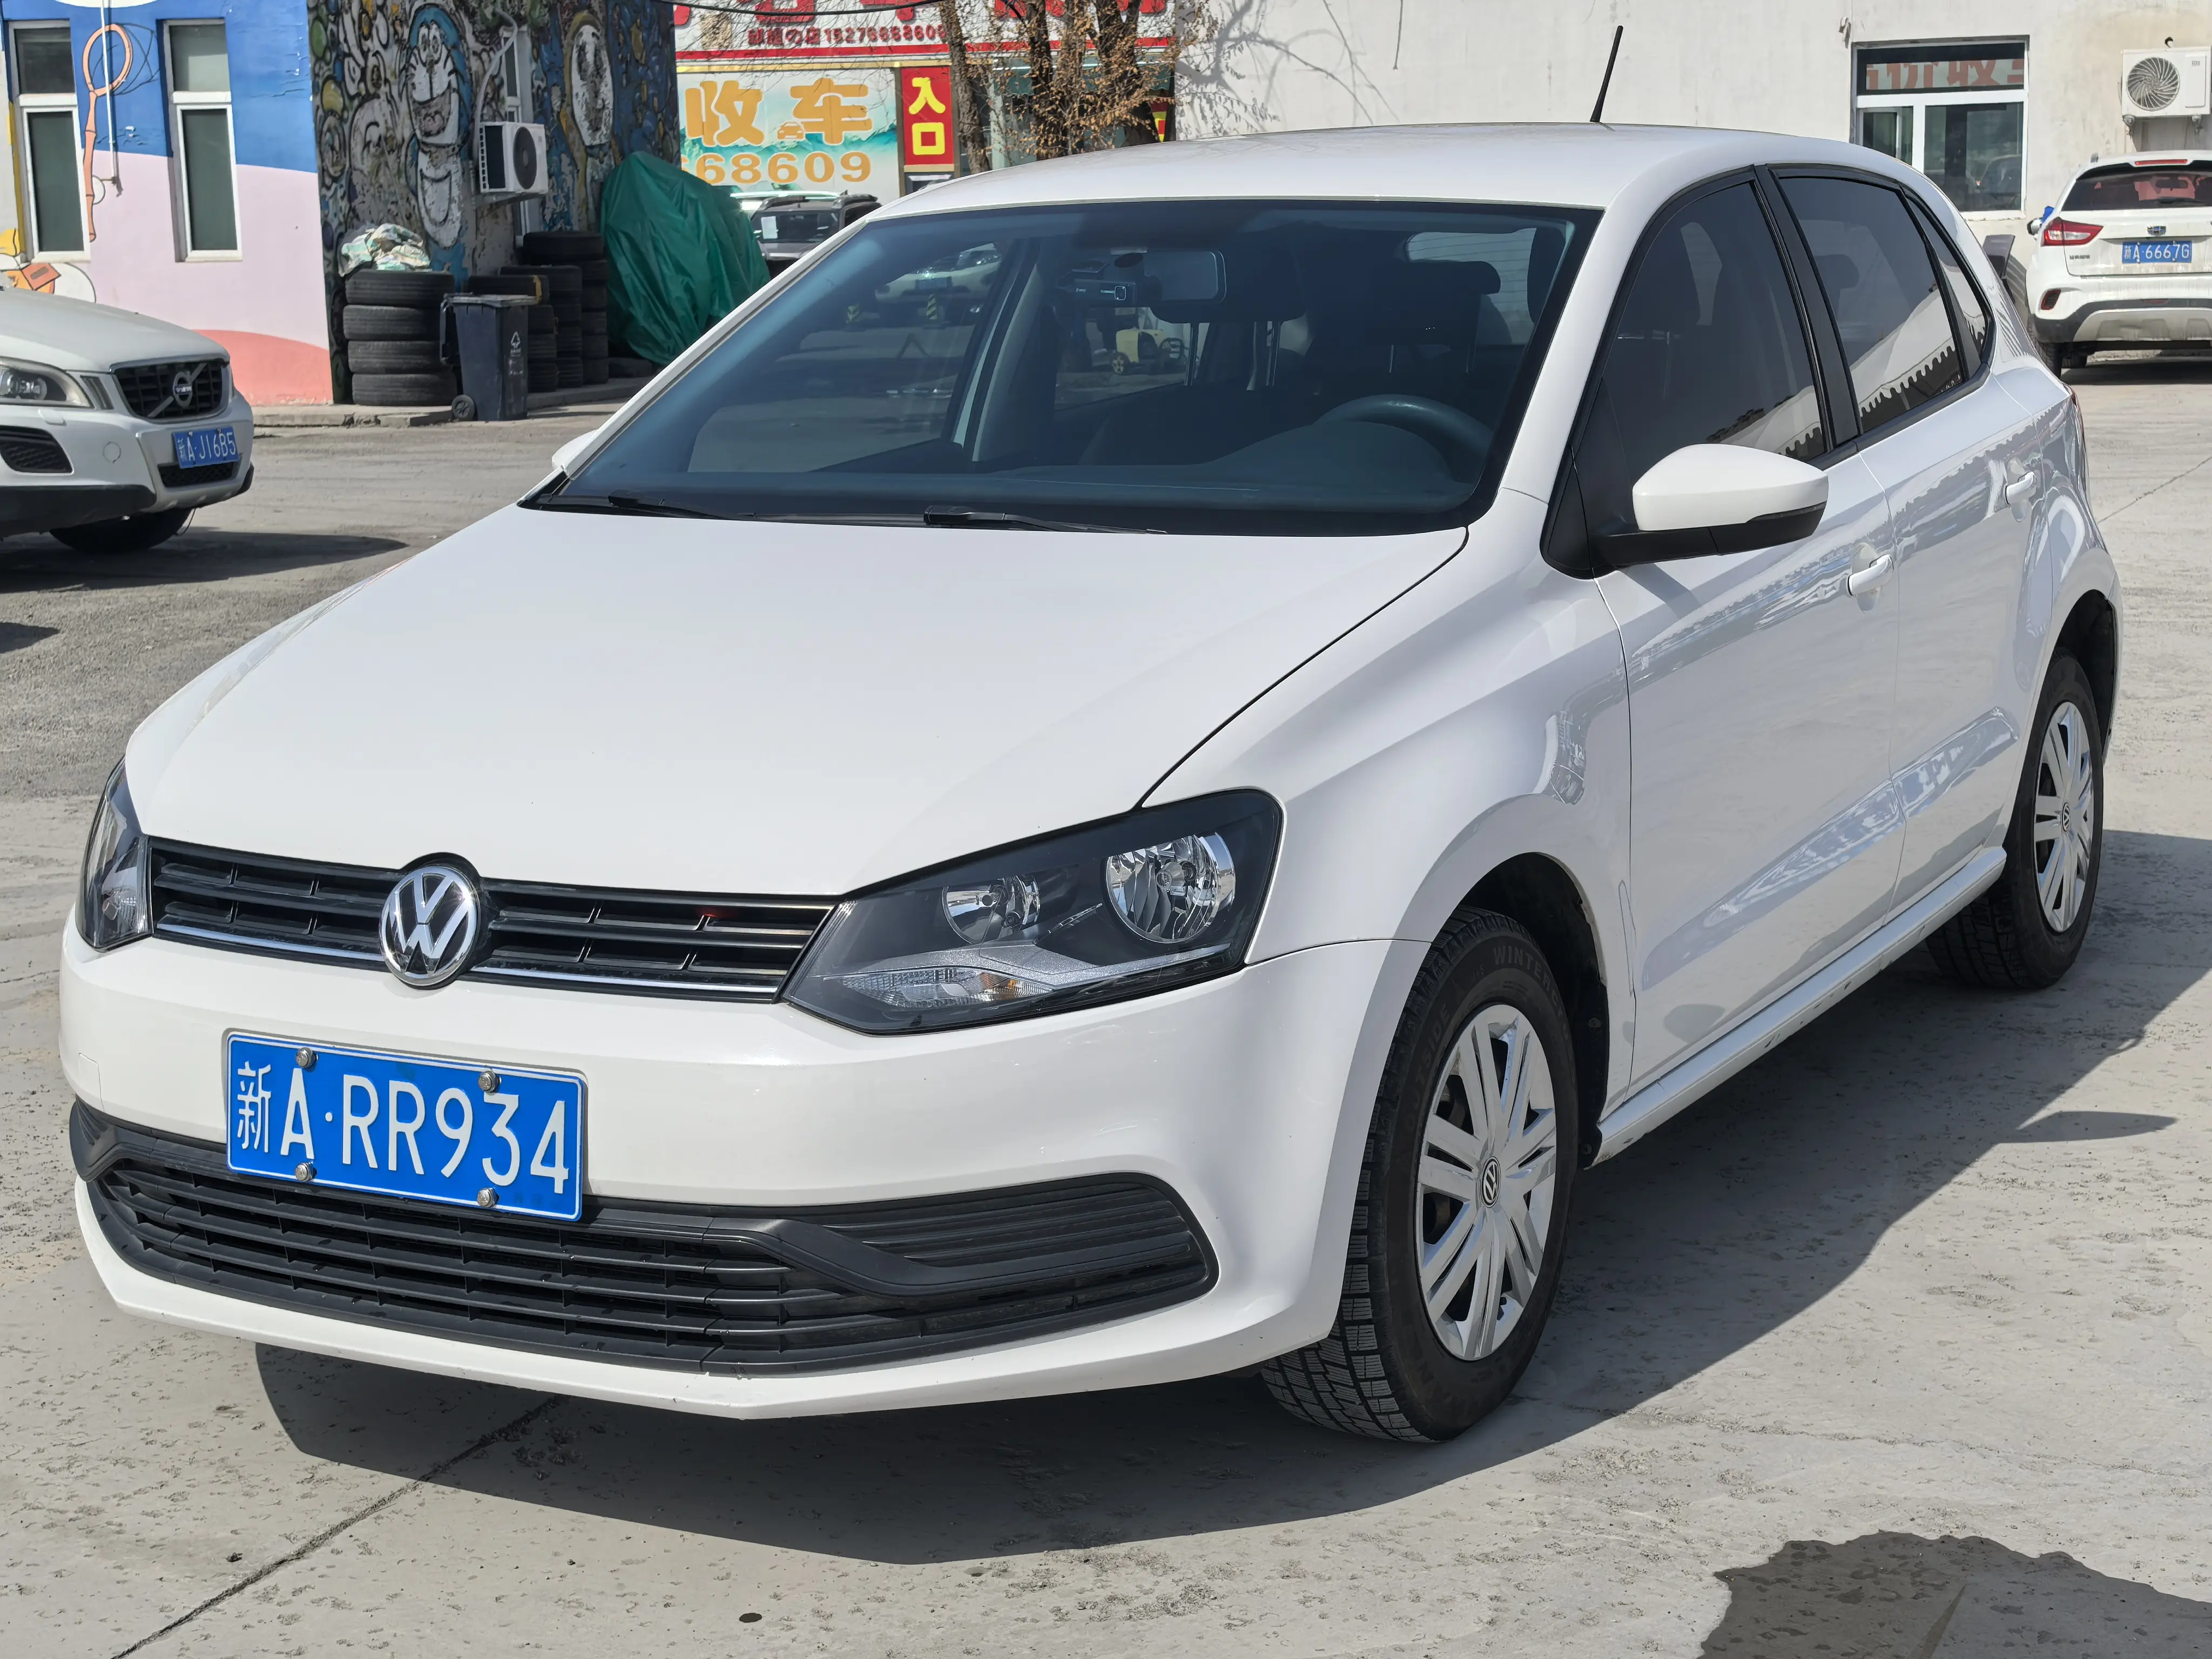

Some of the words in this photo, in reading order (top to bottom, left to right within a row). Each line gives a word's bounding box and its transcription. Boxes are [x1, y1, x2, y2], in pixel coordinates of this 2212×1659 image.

[684, 78, 873, 146] 收车
[908, 77, 946, 156] 入口
[681, 151, 871, 184] 68609
[237, 1060, 570, 1195] 新A·RR934
